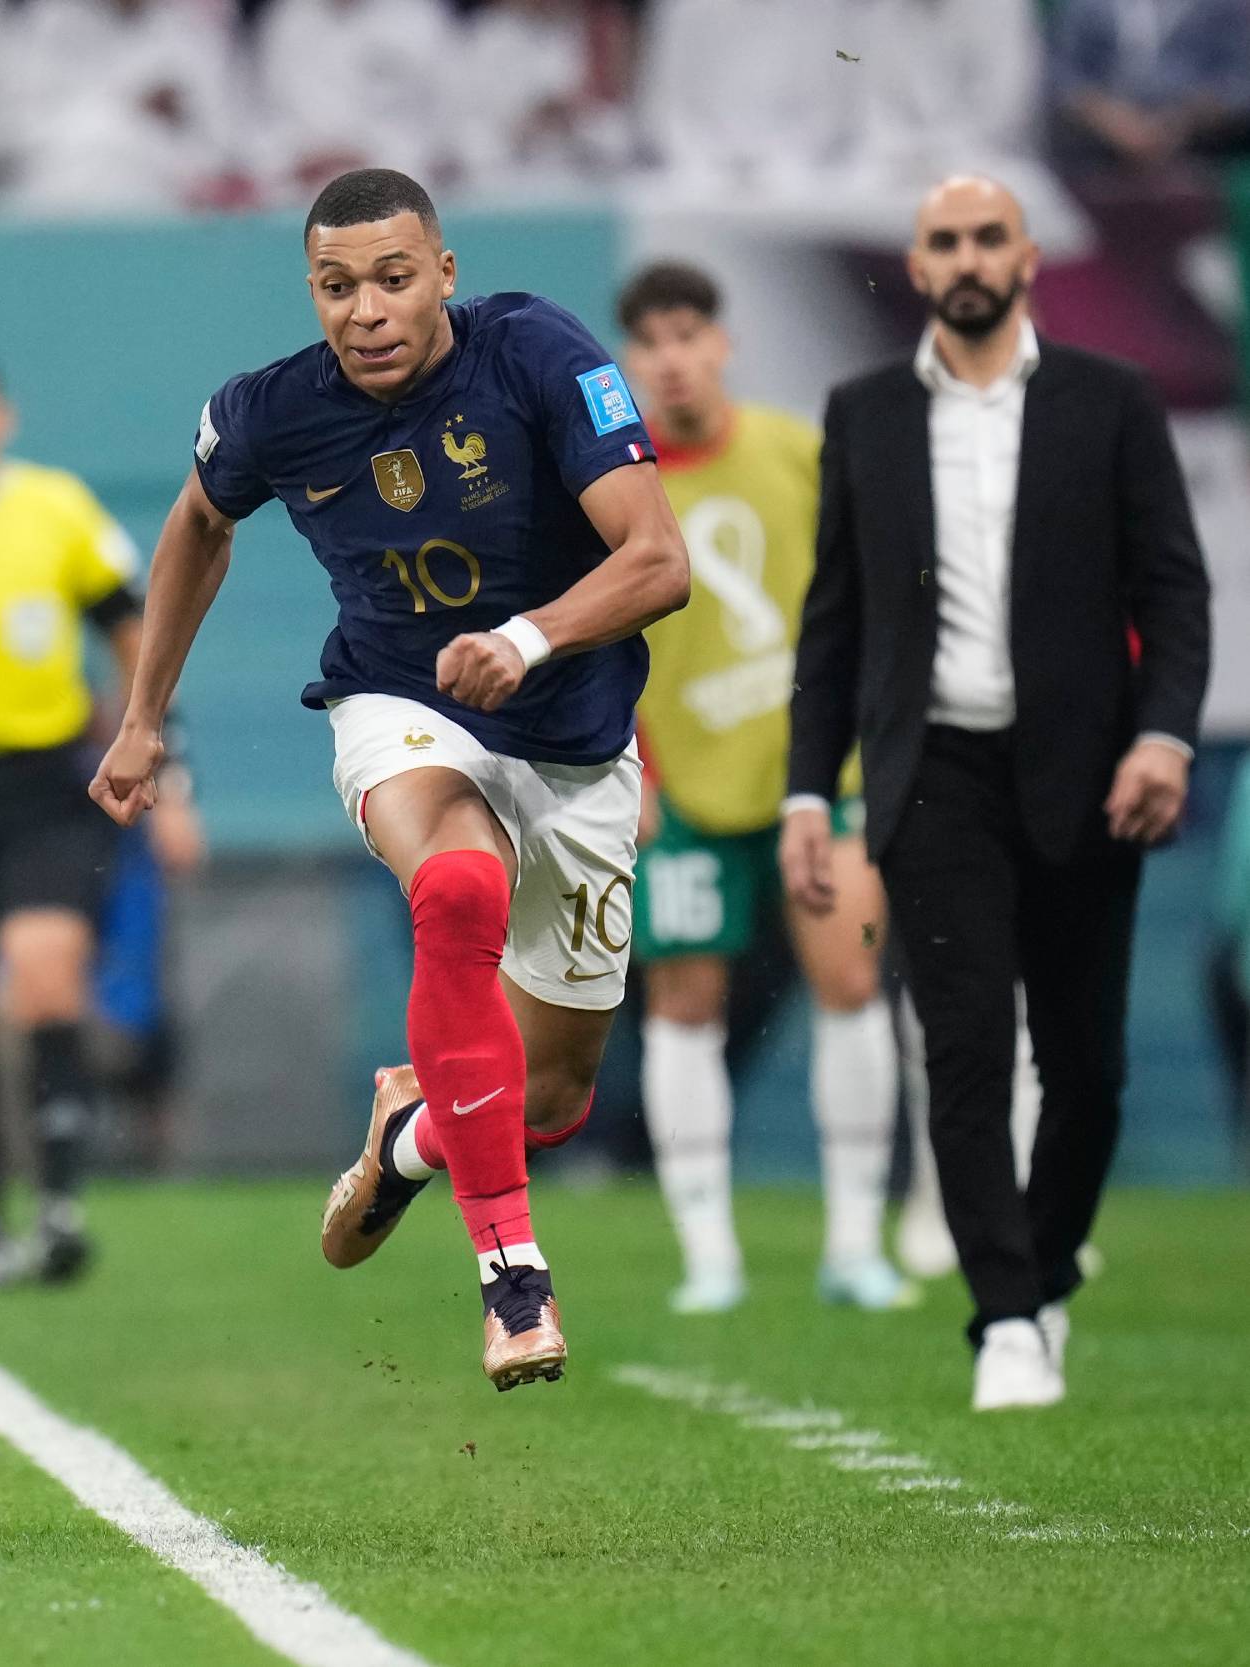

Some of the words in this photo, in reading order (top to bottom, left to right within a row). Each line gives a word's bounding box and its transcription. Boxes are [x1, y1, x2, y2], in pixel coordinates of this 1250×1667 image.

[393, 487, 413, 497] FIFA
[382, 538, 480, 613] 10
[562, 875, 631, 953] 10
